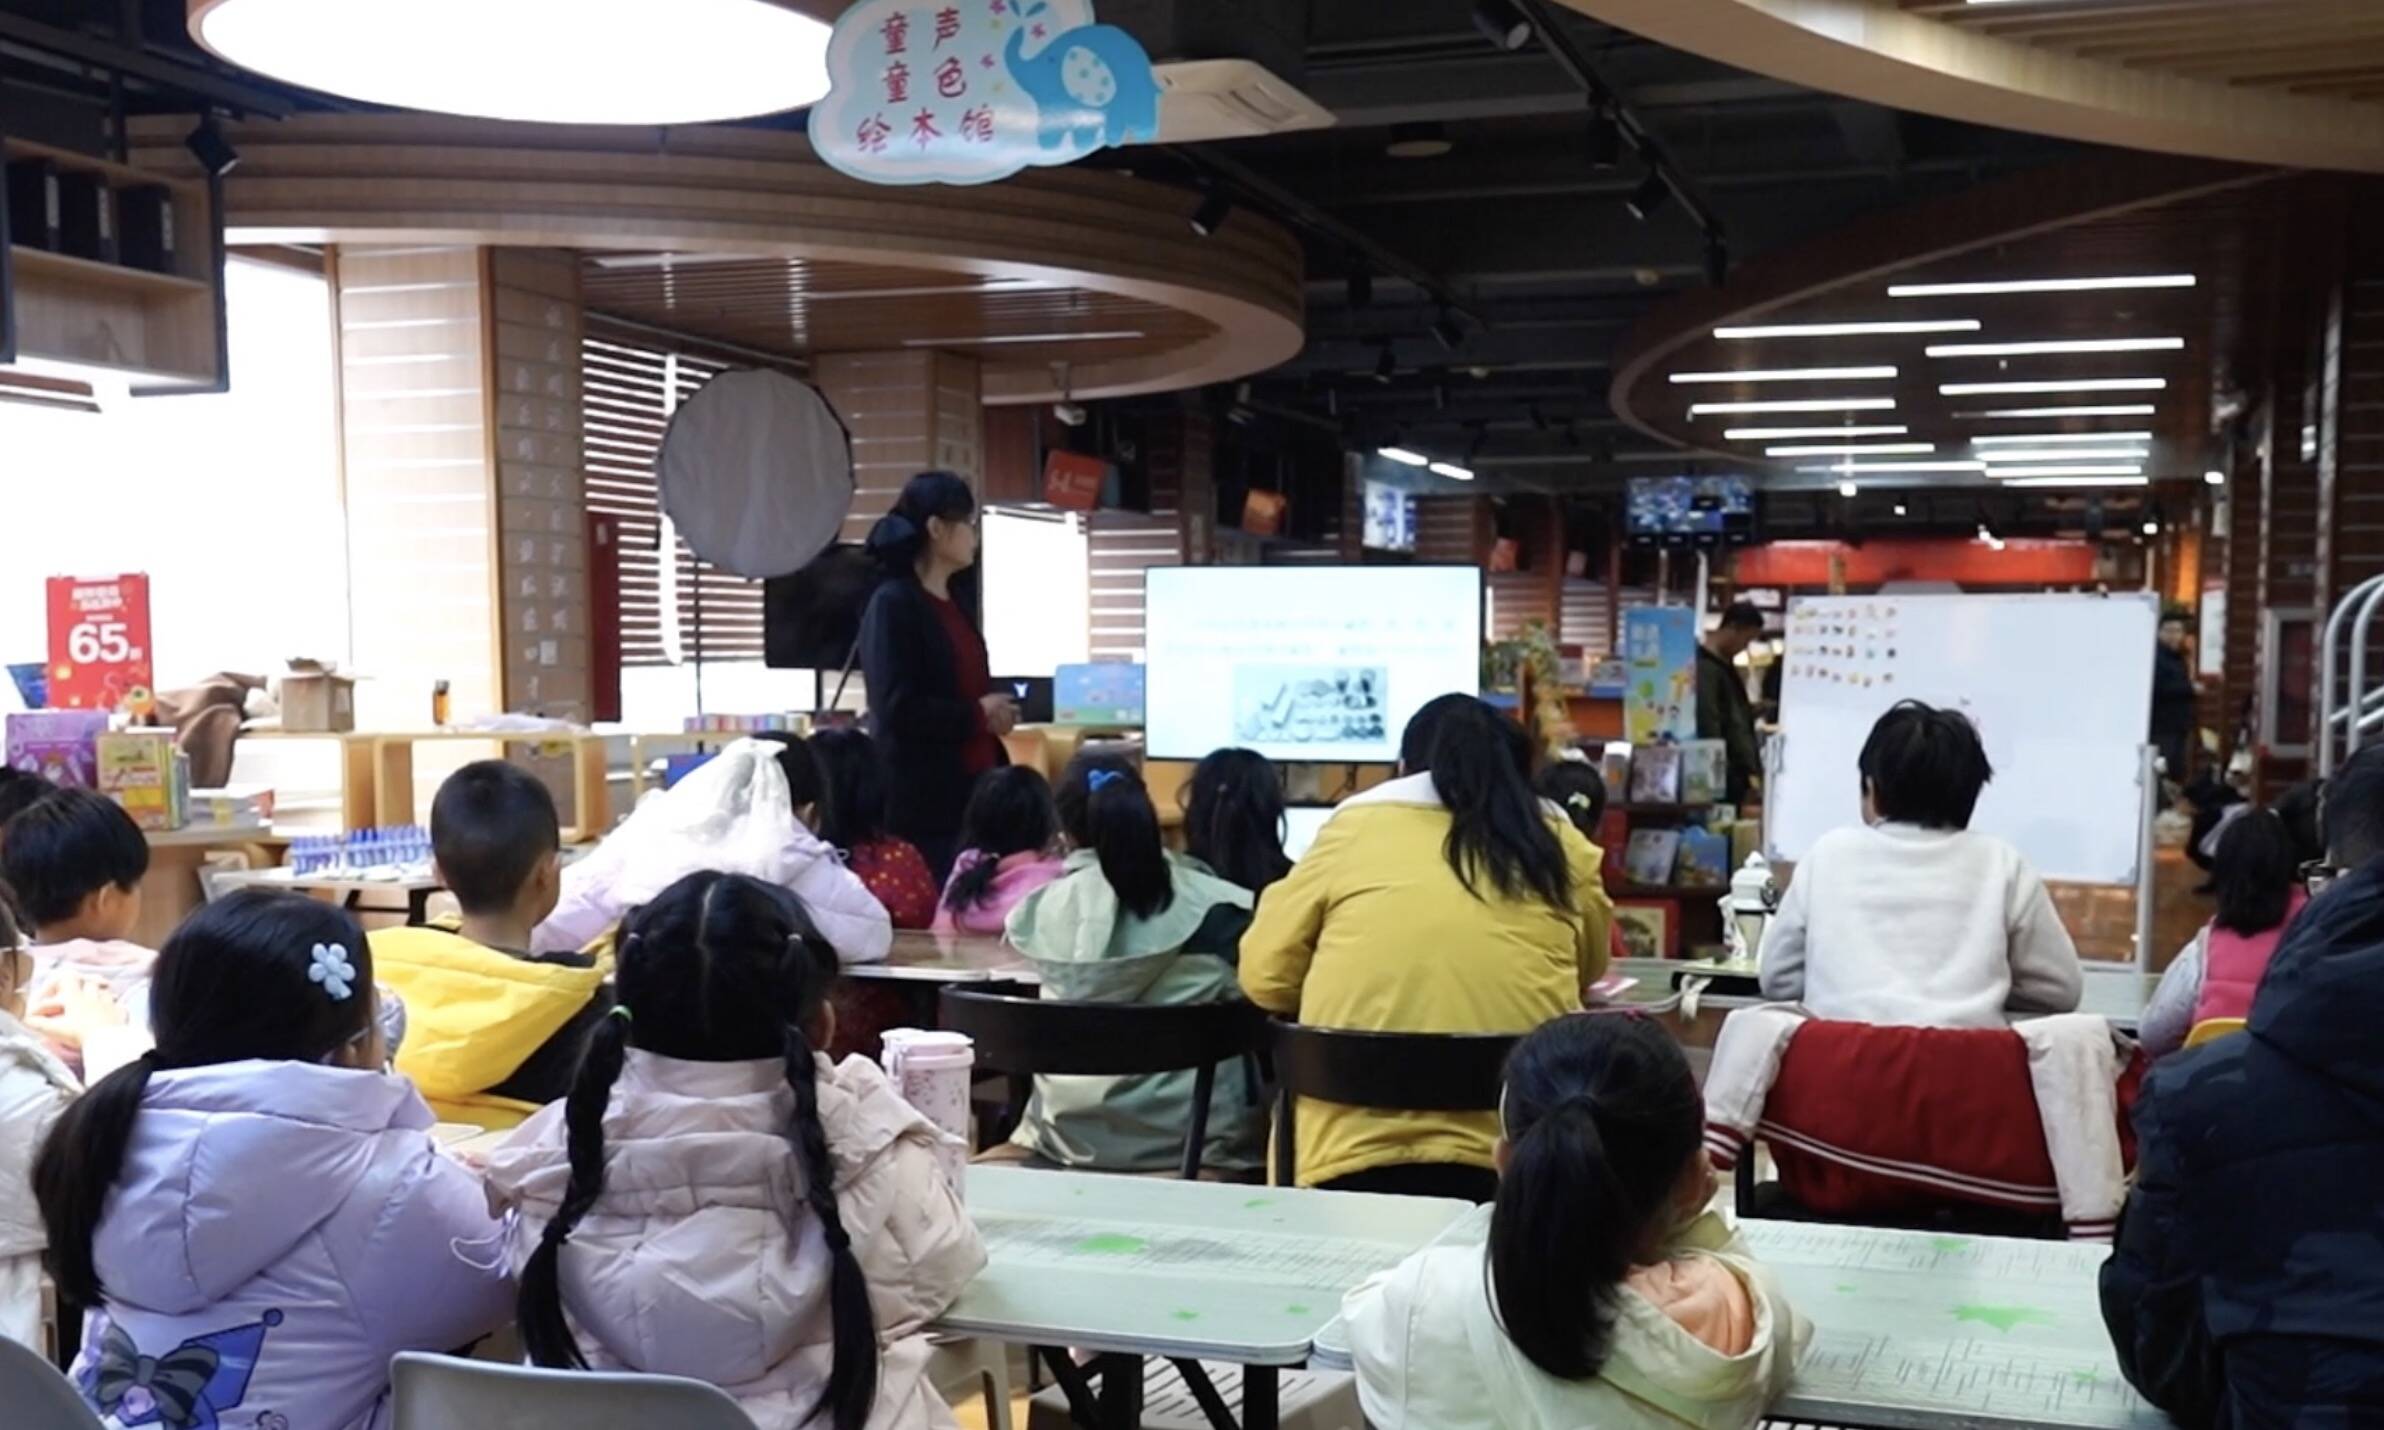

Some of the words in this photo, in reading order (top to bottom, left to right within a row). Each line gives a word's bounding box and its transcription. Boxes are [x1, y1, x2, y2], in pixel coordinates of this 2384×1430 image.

[879, 7, 961, 55] 童声
[881, 56, 966, 103] 童色
[856, 103, 995, 154] 绘本馆
[69, 622, 129, 664] 65
